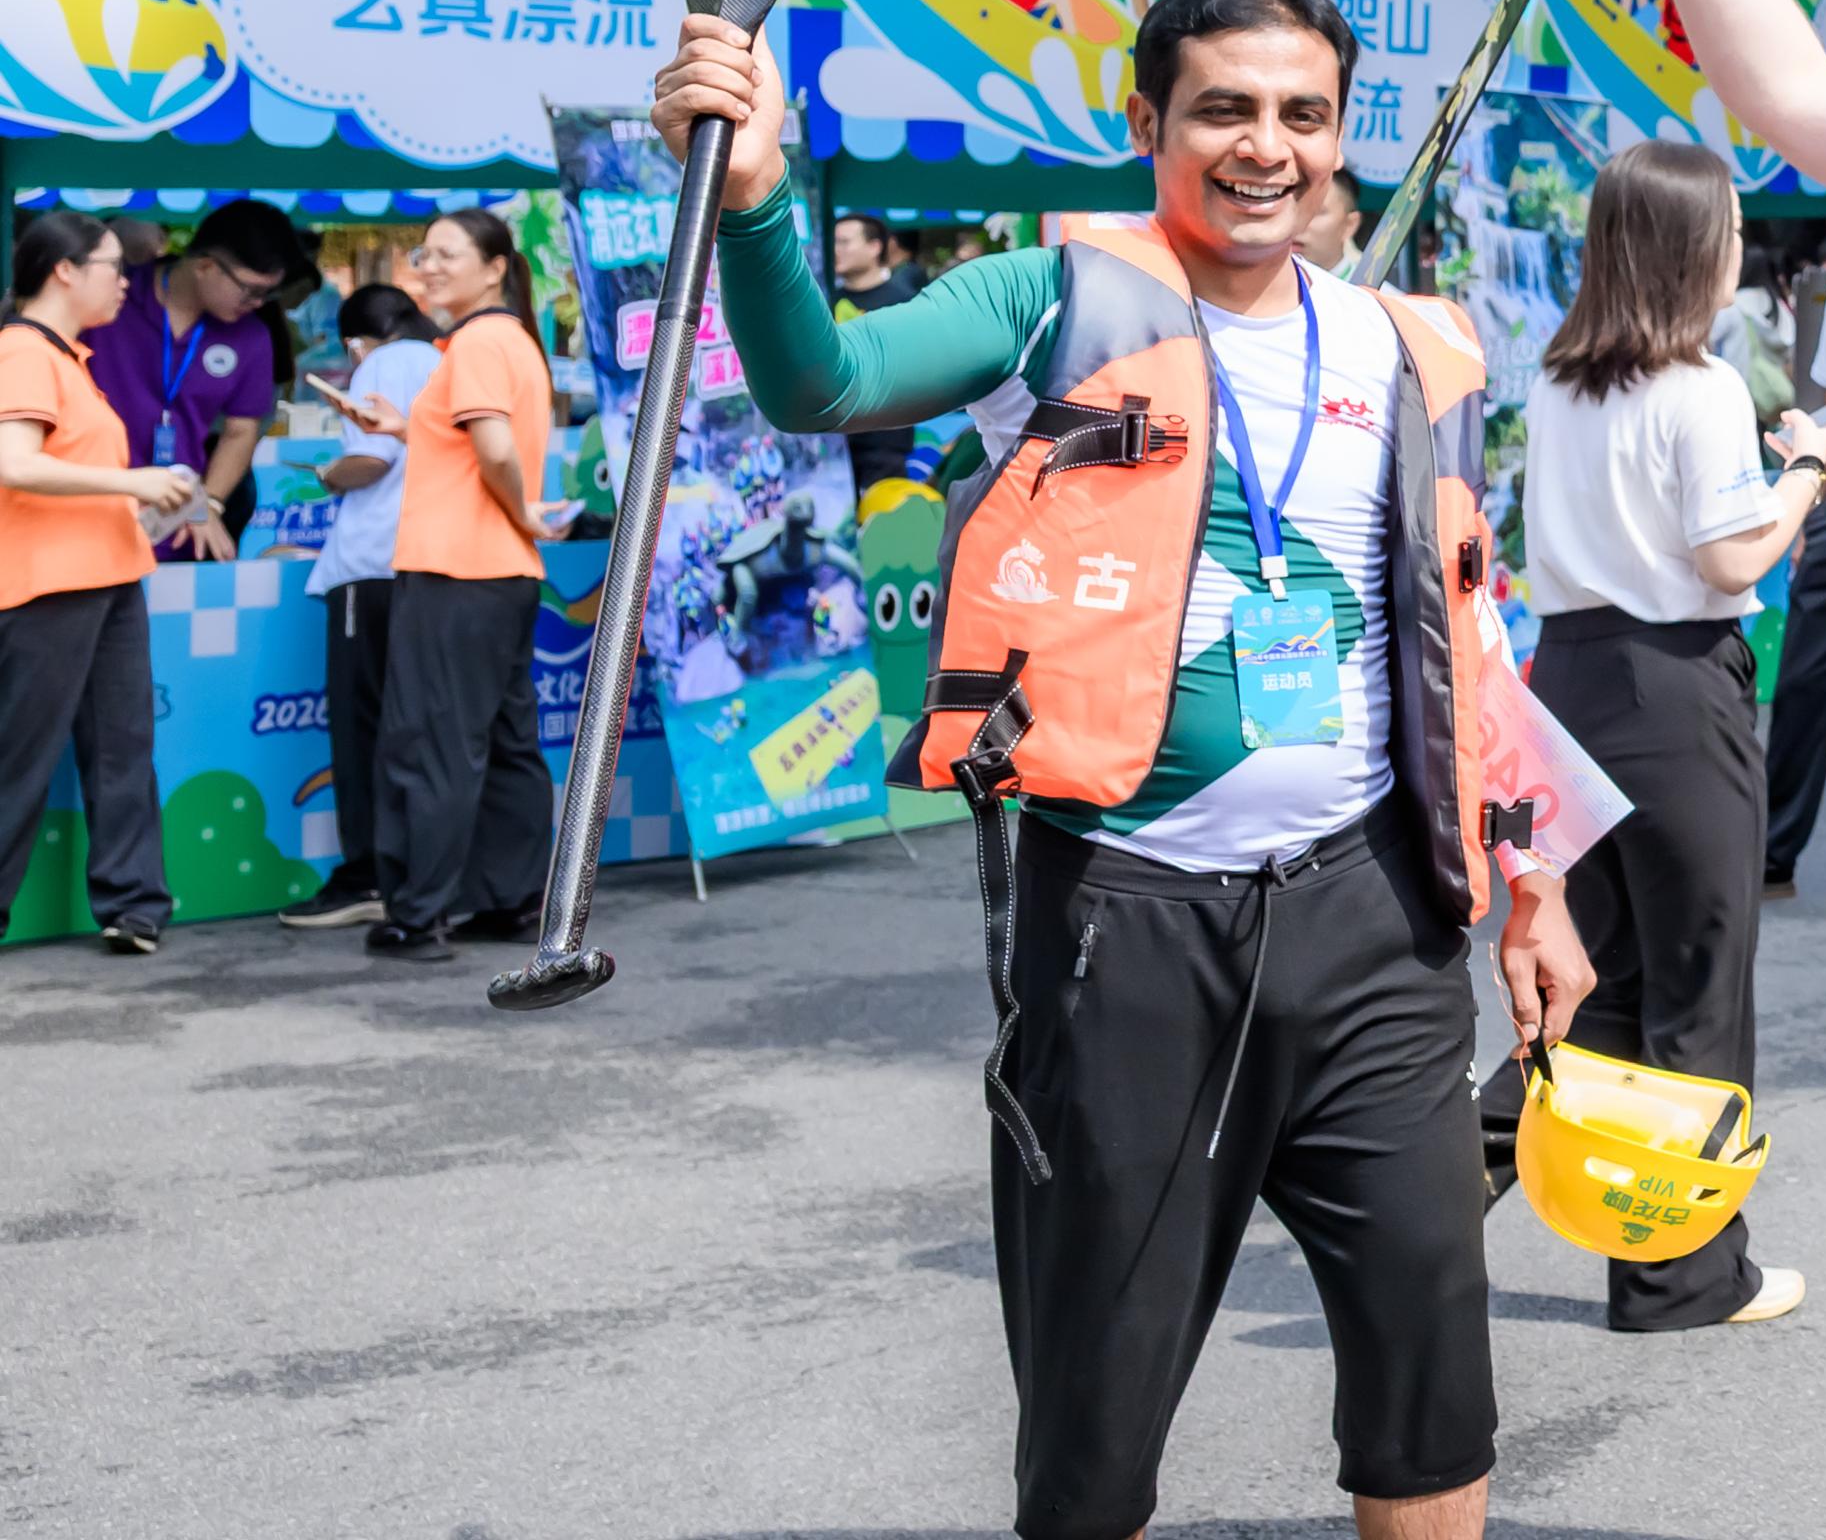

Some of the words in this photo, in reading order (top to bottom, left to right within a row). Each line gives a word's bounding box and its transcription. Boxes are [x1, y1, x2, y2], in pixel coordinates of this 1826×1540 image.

[1354, 77, 1402, 141] 流
[1073, 551, 1137, 611] 古
[1262, 671, 1313, 691] 运动员
[1602, 1186, 1691, 1226] 古龙峡
[1638, 1175, 1675, 1198] VIP
